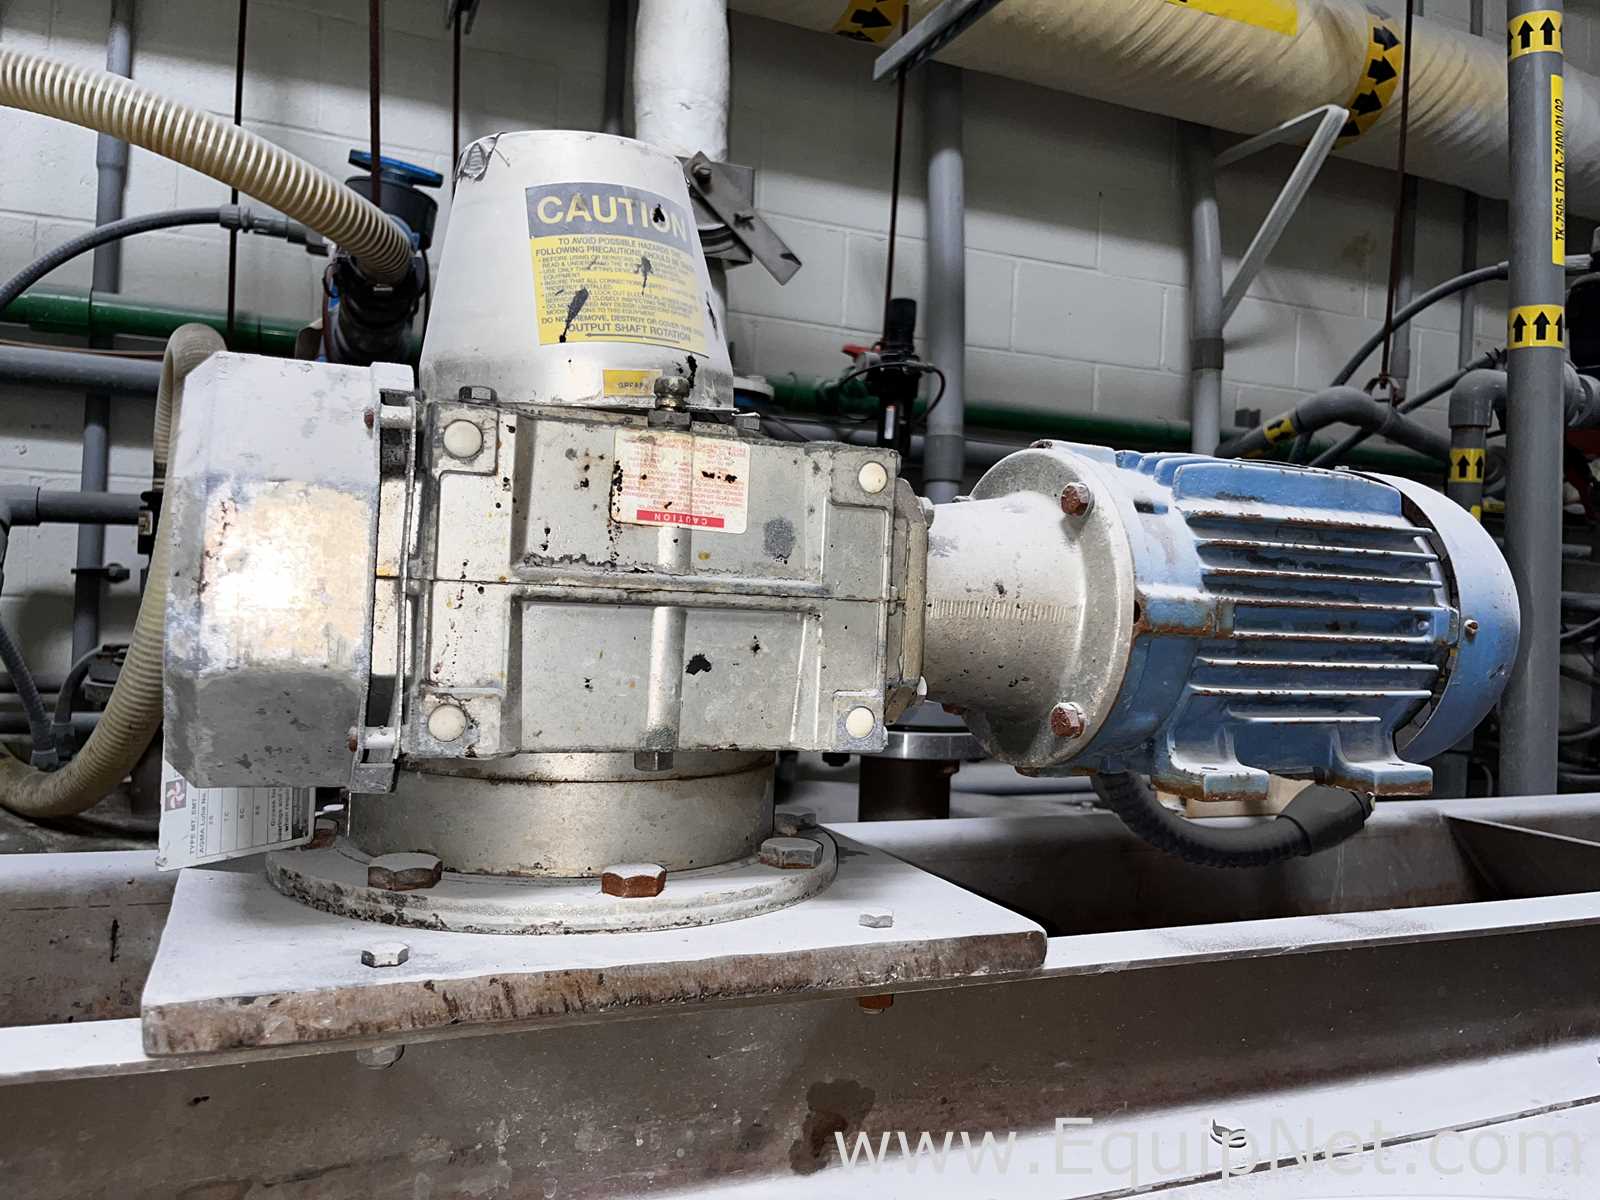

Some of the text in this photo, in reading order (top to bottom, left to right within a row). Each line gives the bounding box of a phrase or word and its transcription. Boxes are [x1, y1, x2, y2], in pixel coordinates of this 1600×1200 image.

[1555, 178, 1565, 193] TO
[537, 194, 688, 242] CAUTION
[573, 237, 596, 245] AVOID
[598, 238, 635, 247] POSSIBLE
[536, 246, 584, 256] FOLLOWING
[587, 245, 642, 256] PRECAUTIONS
[541, 317, 554, 325] DO
[611, 316, 645, 324] DESTROY
[568, 323, 691, 341] OUTPUT SHAFT ROTATION
[654, 513, 708, 526] CAUTION
